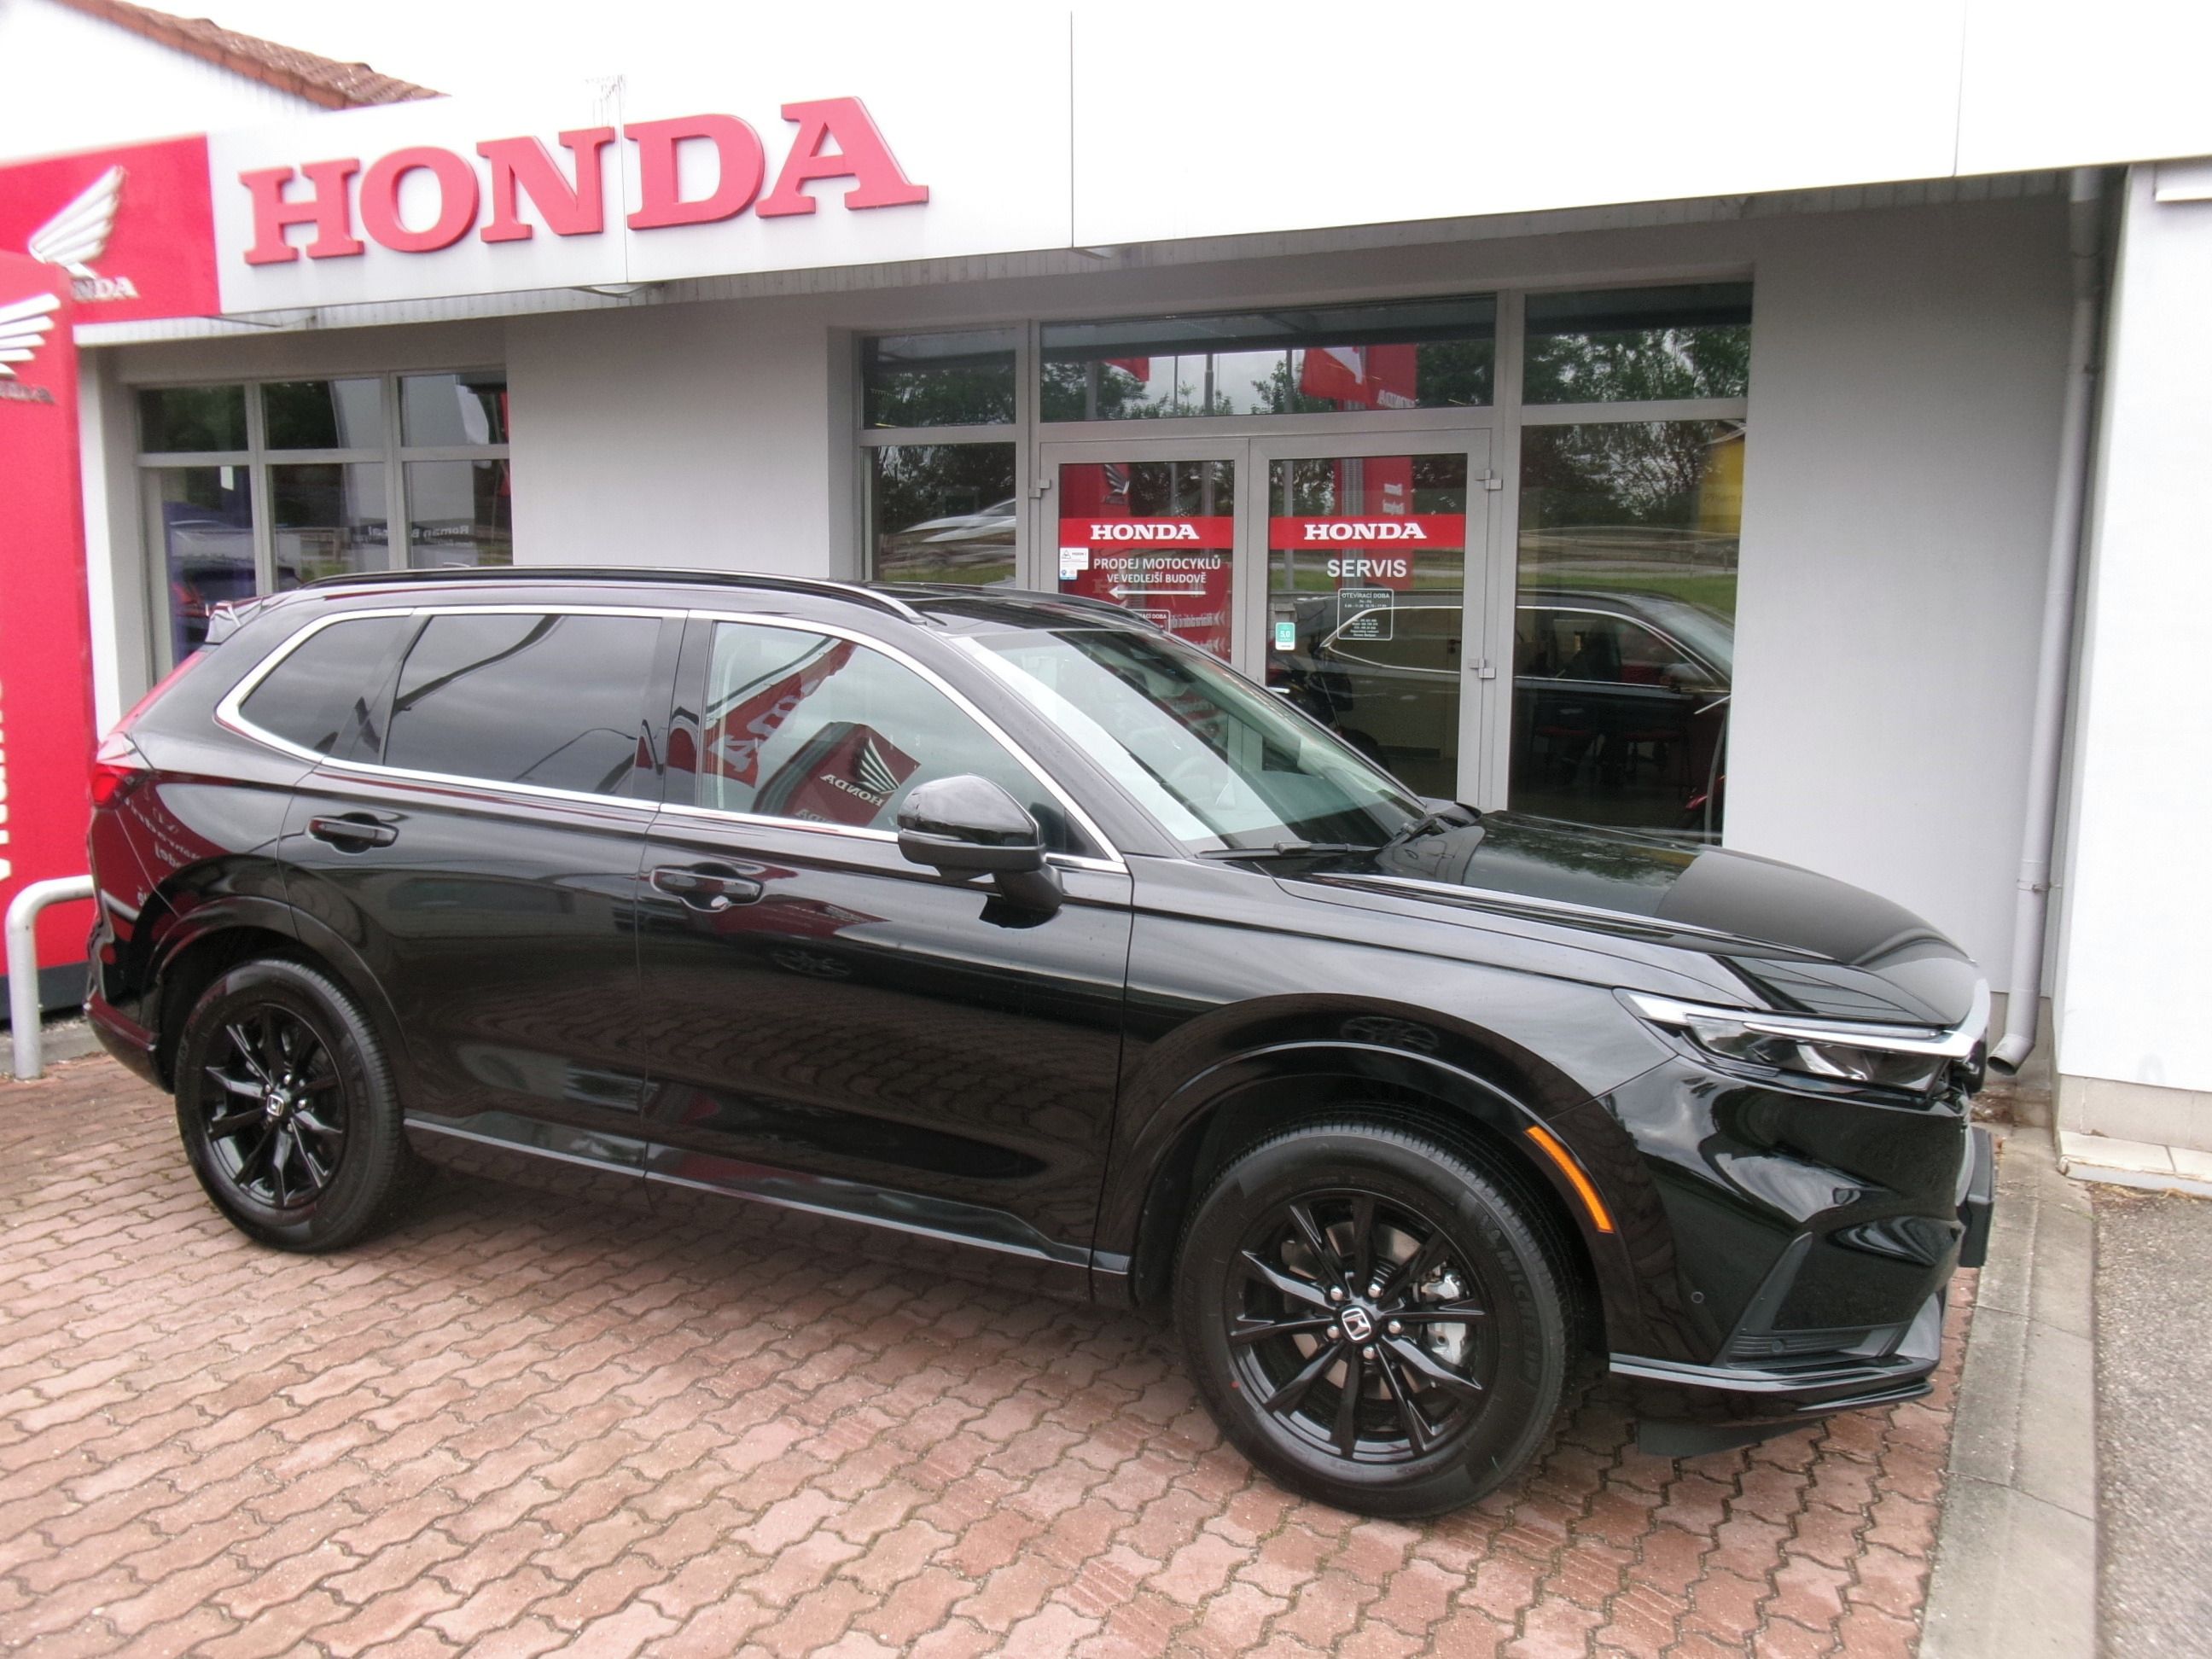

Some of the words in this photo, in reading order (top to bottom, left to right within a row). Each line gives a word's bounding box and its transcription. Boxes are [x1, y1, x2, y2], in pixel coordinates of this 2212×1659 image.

[239, 96, 928, 265] HONDA
[71, 276, 139, 300] NDA
[1091, 524, 1200, 540] HONDA
[1304, 522, 1427, 540] HONDA
[1093, 558, 1138, 569] PRODEJ
[1143, 555, 1220, 569] MOTOCYKLŮ
[1327, 559, 1407, 578] SERVIS
[1107, 573, 1119, 583] VE
[1121, 572, 1162, 583] VEDLEJŠÍ
[1166, 573, 1206, 583] BUDOVĚ
